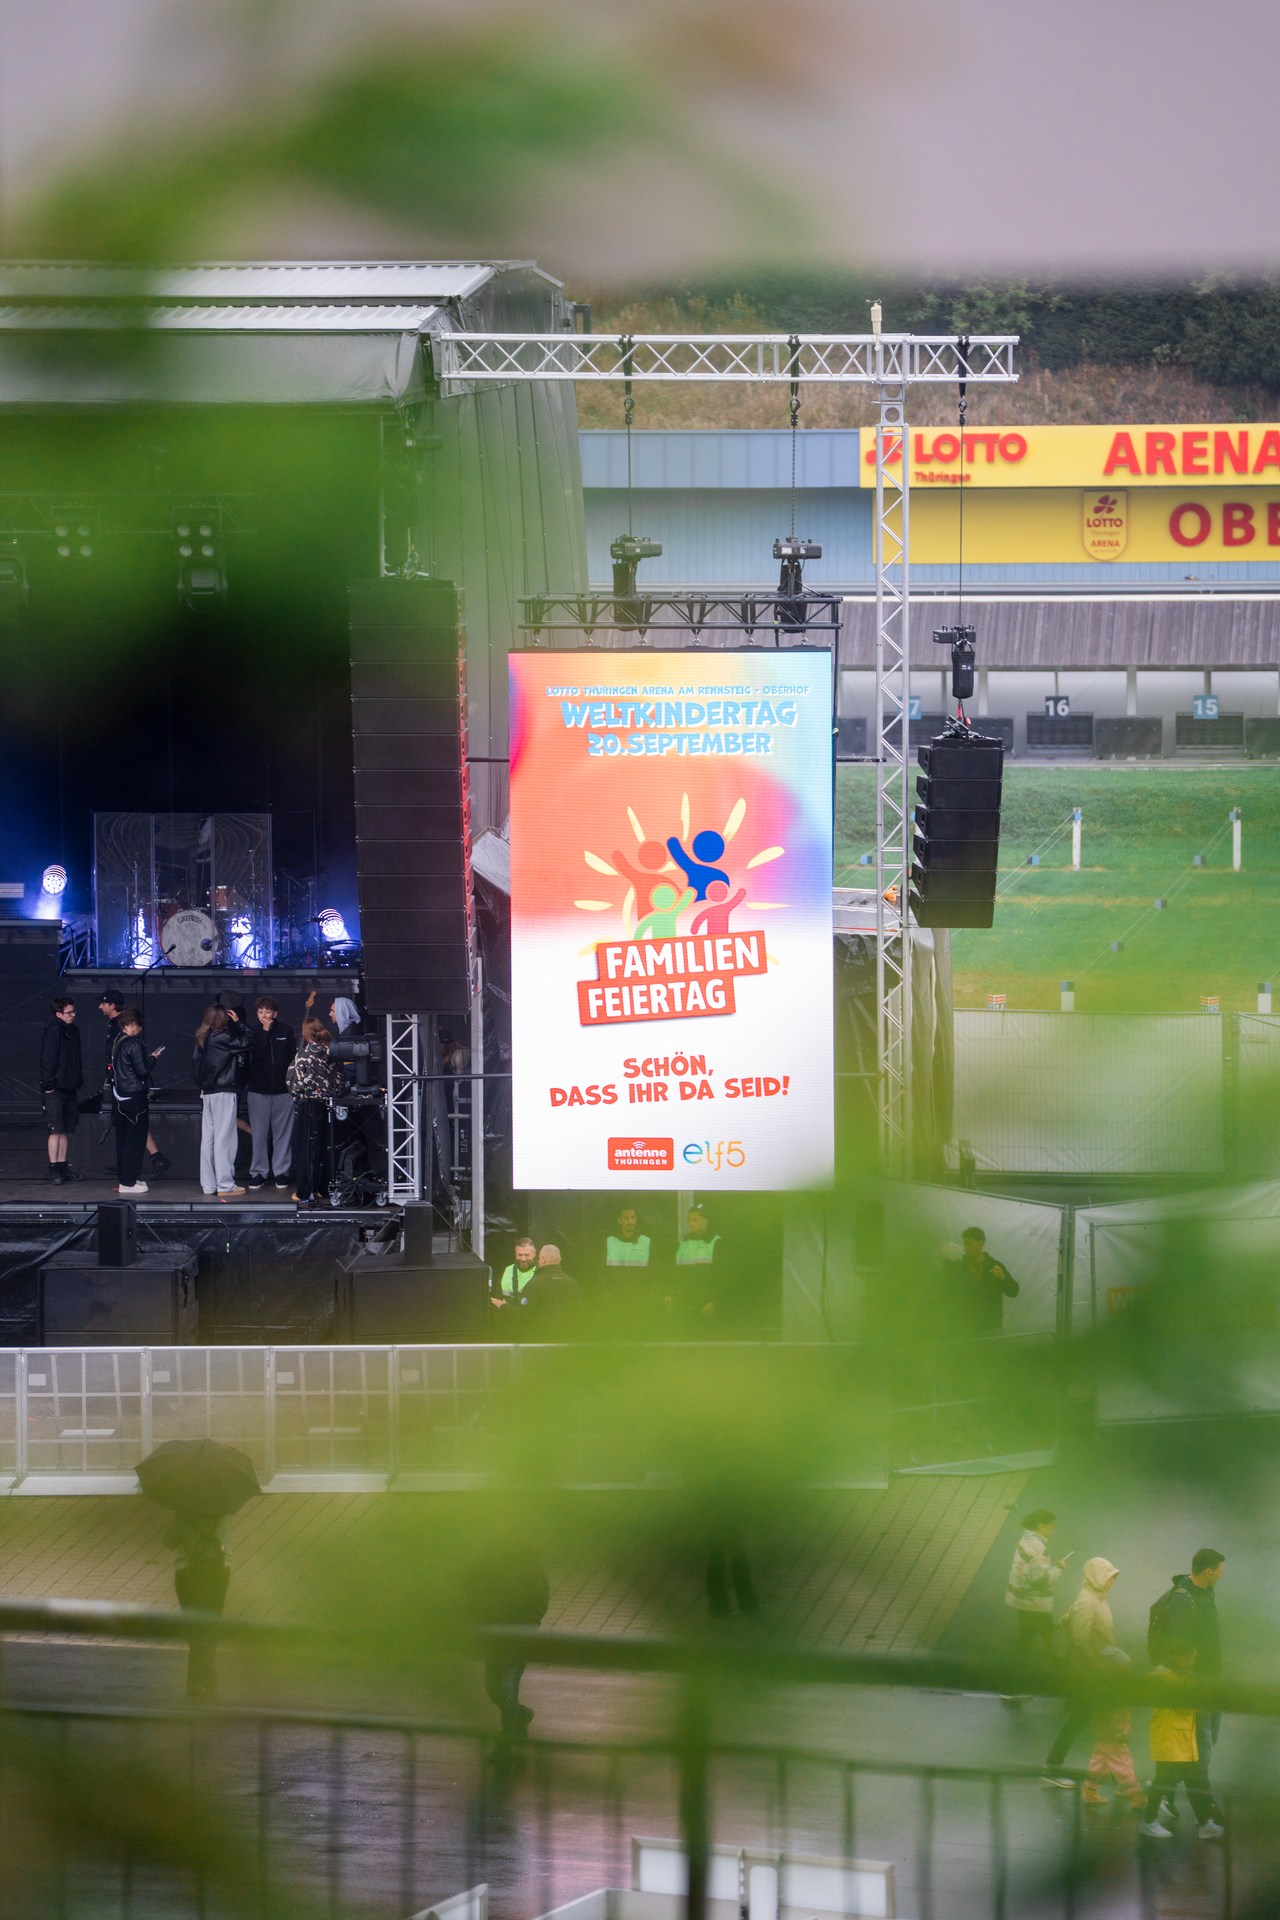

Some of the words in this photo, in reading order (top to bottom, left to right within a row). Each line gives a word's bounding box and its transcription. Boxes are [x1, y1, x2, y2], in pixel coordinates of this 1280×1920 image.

[914, 433, 1027, 464] LOTTO
[1103, 430, 1280, 475] ARENA
[1086, 518, 1124, 528] LOTTO
[546, 686, 580, 696] LOTTO
[641, 686, 675, 696] ARENA
[678, 686, 695, 696] AM
[698, 686, 752, 695] RENNSTEIG
[762, 685, 811, 695] OBERHOF
[561, 701, 798, 728] WELTKINDERTAG
[1046, 699, 1070, 716] 16
[1194, 699, 1219, 716] 15
[587, 732, 773, 756] 20.SEPTEMBER
[605, 936, 760, 979] FAMILIEN
[588, 978, 727, 1018] FEIERTAG
[623, 1051, 714, 1079] SCHÖN,
[550, 1083, 618, 1107] DASS
[629, 1081, 669, 1103] IHR
[679, 1079, 715, 1100] DA
[724, 1075, 790, 1098] SEID!
[614, 1147, 668, 1158] antenne
[614, 1157, 668, 1165] THÜRINGEN
[682, 1141, 746, 1171] elf5
